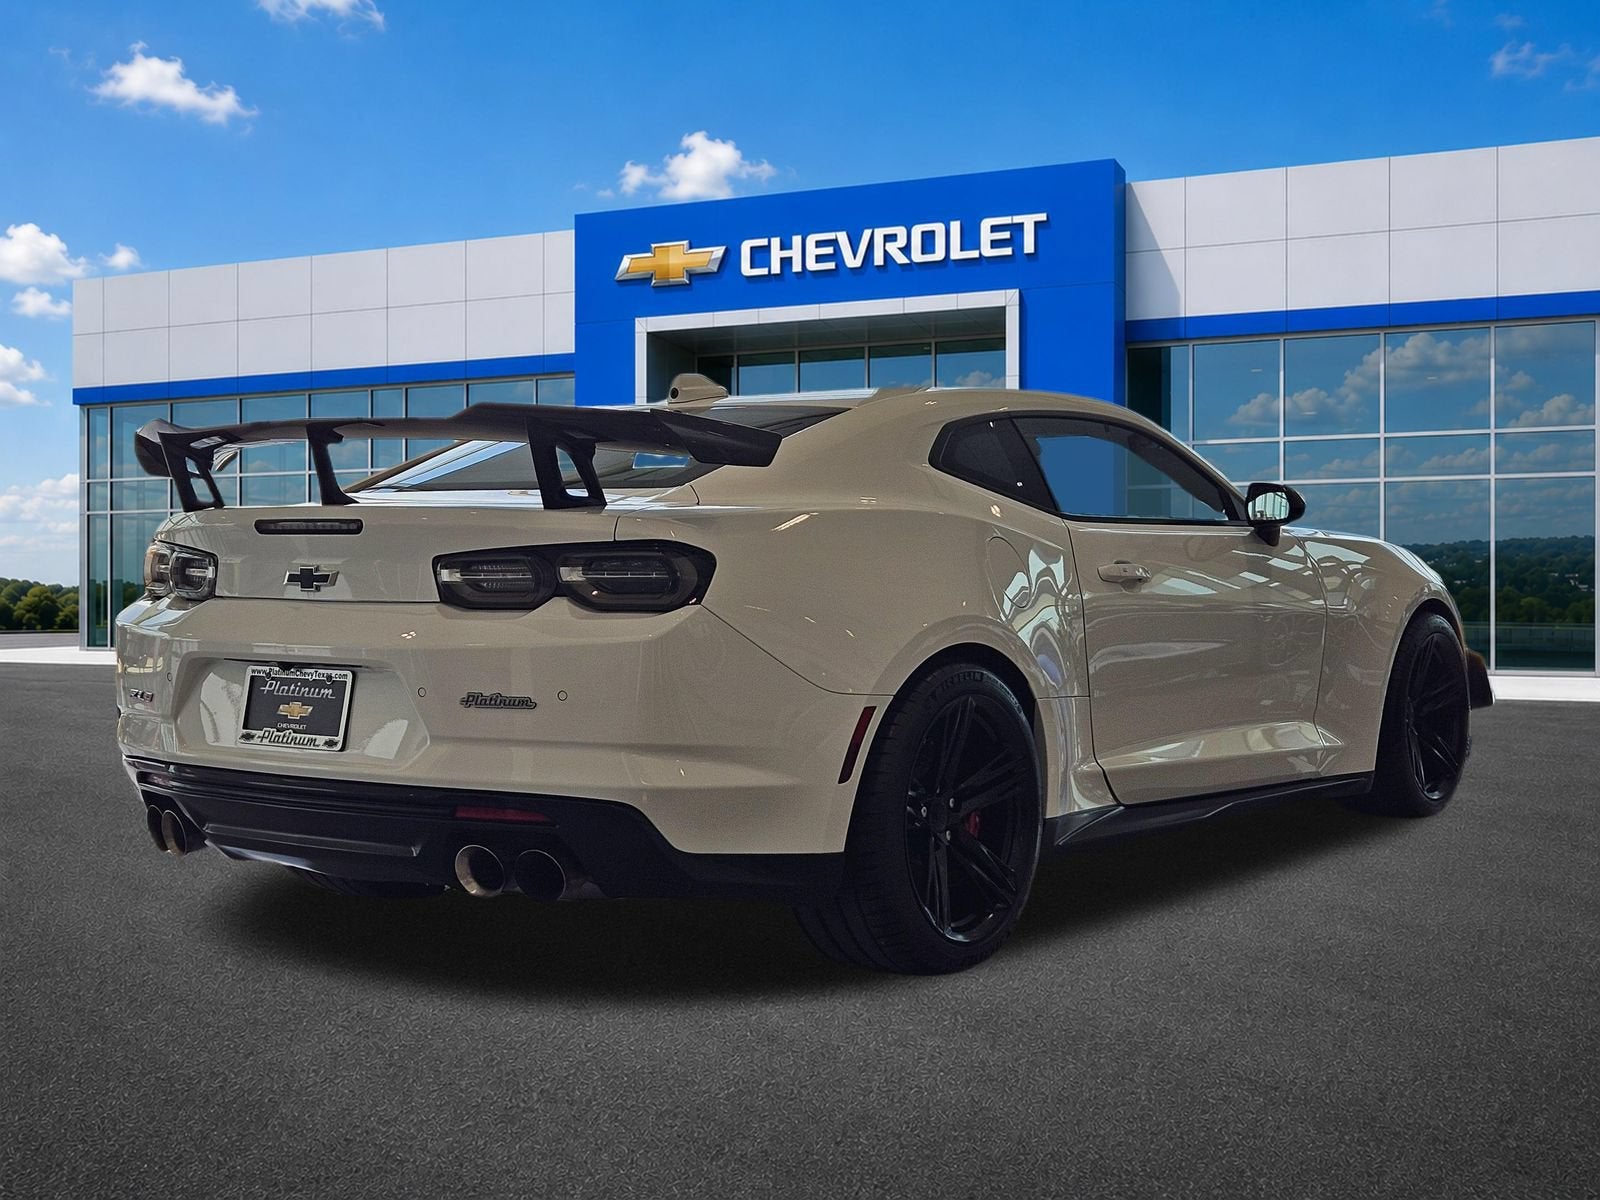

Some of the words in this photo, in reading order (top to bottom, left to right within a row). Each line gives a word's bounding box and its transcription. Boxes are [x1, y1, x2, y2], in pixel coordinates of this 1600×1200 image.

[740, 212, 1047, 277] CHEVROLET
[260, 680, 336, 699] Platinum
[460, 692, 537, 709] Platinum
[277, 722, 307, 730] CHEVROLET
[256, 729, 320, 747] Platinum
